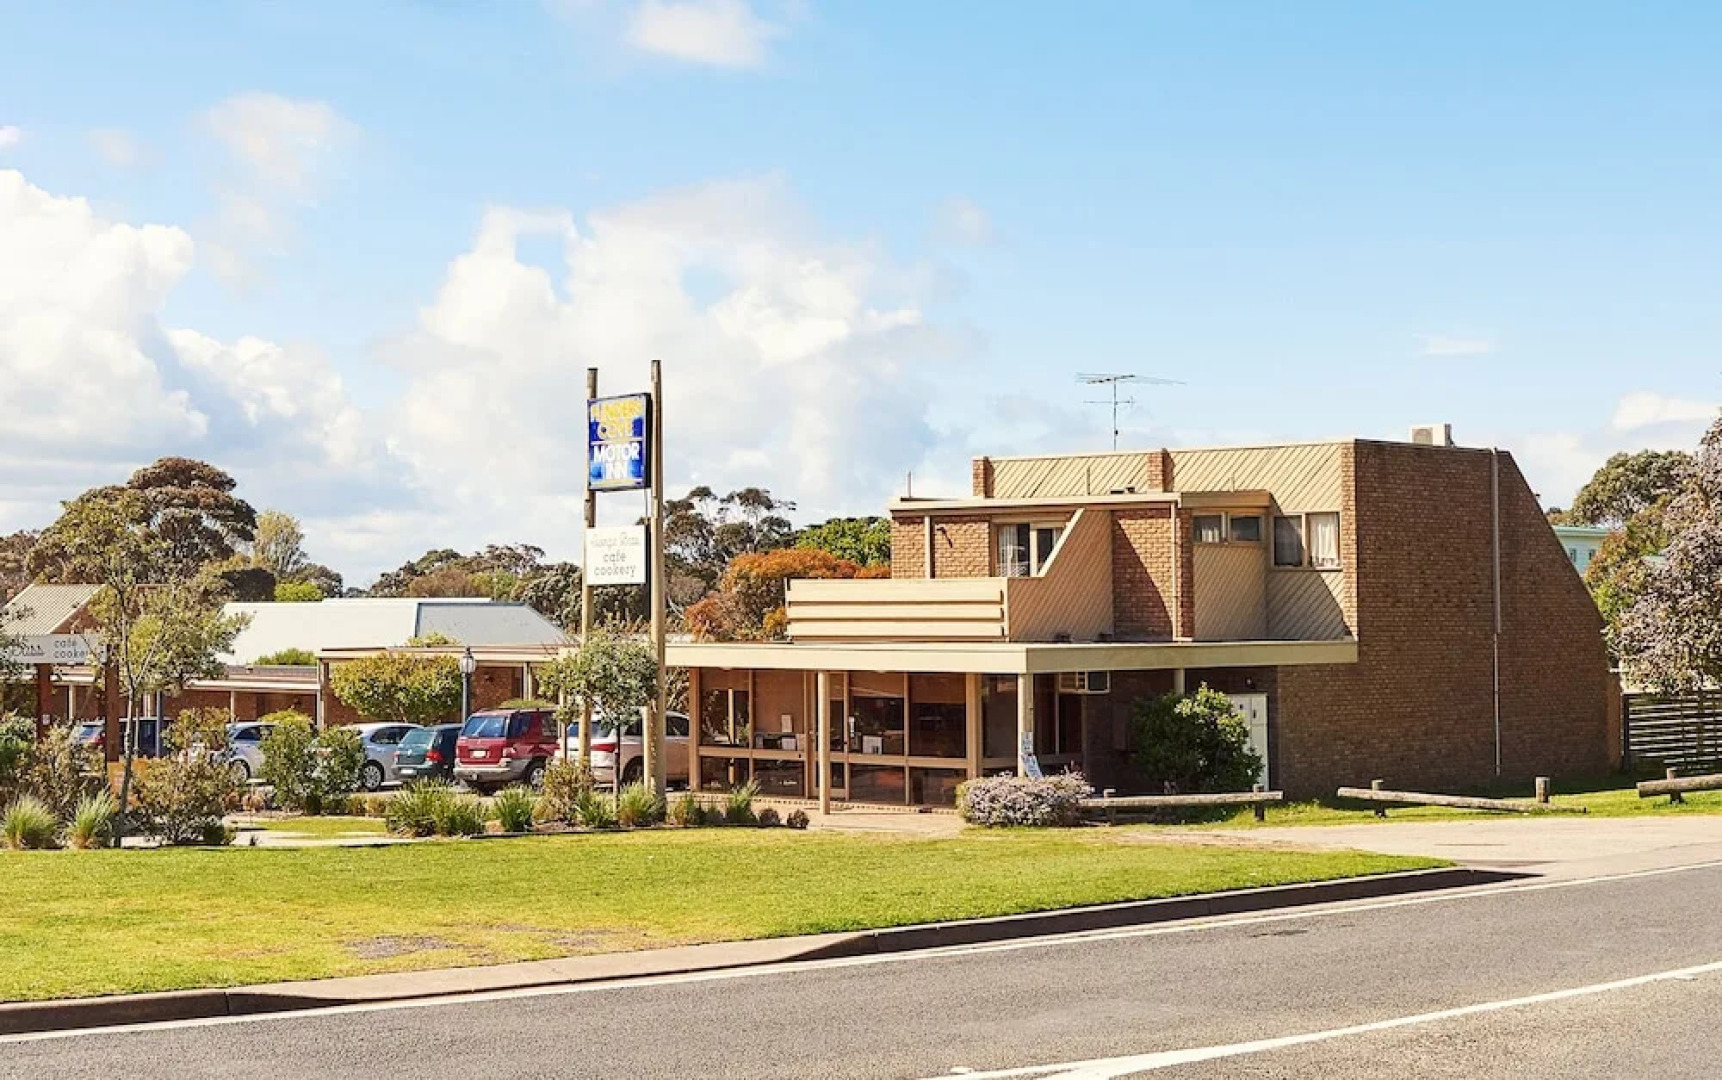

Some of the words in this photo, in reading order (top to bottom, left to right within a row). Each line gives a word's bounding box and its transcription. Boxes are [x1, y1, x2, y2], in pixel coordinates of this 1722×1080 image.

[594, 442, 640, 463] MOTOR
[594, 563, 636, 577] cookery
[54, 648, 88, 658] cooke
